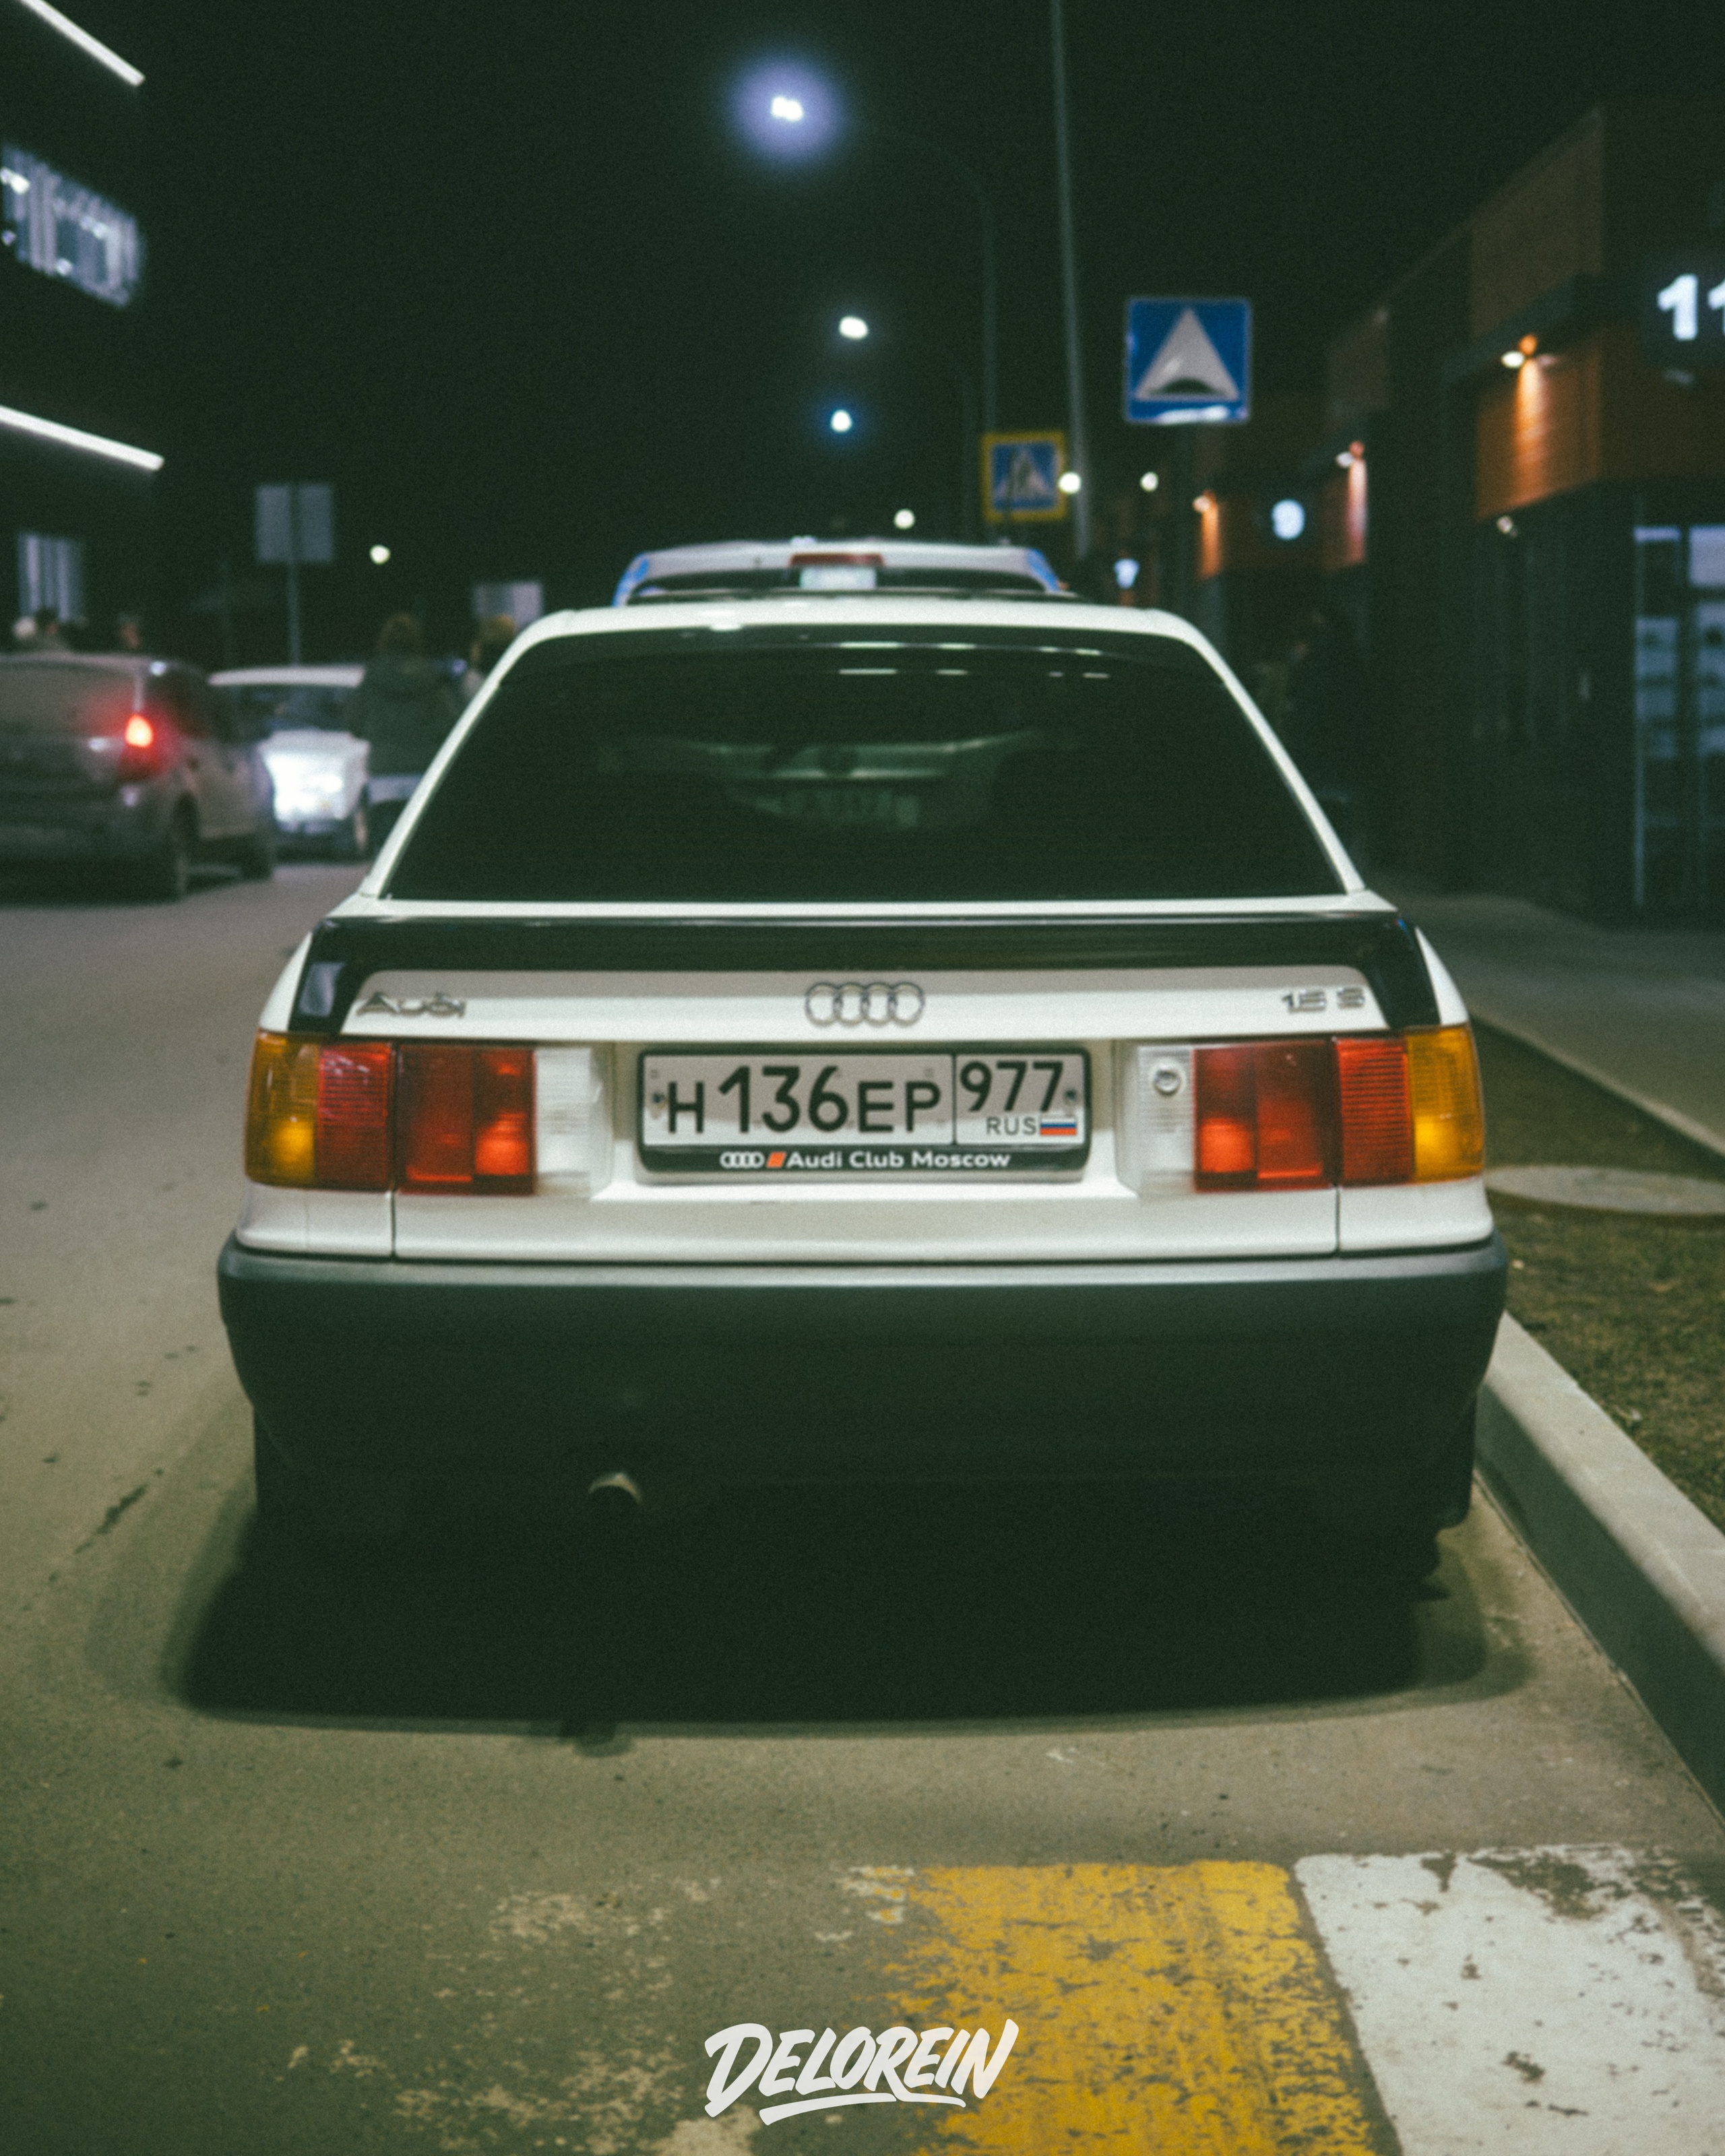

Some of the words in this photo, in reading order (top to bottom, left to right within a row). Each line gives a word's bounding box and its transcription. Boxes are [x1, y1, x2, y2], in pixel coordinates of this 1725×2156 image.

[960, 1060, 1064, 1112] 977
[986, 1116, 1036, 1135] RUS
[786, 1151, 842, 1169] Audi
[849, 1150, 904, 1169] Club
[912, 1151, 1010, 1169] Moscow
